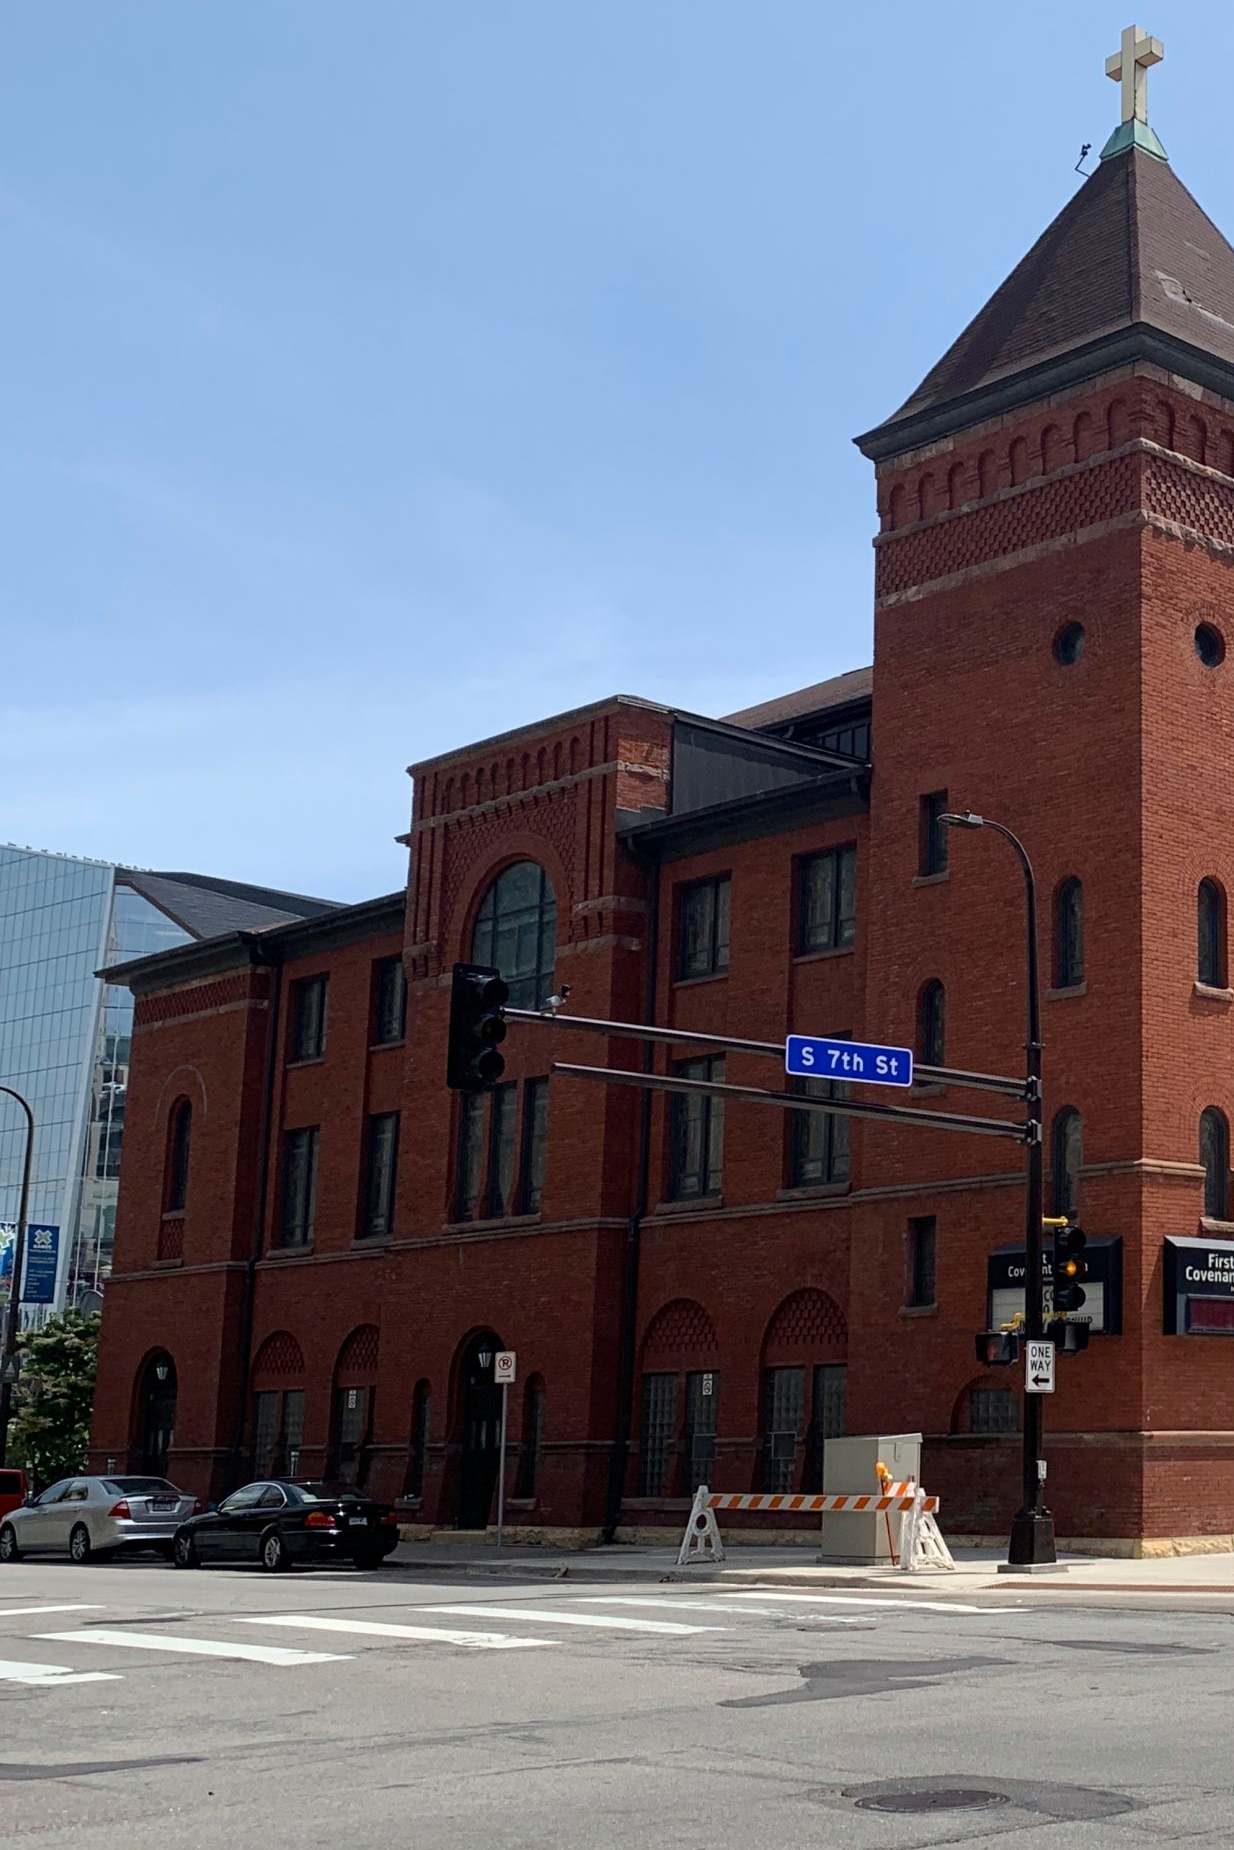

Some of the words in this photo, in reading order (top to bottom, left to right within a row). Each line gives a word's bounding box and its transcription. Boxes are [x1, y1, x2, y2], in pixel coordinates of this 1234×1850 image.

[801, 1046, 815, 1066] S
[827, 1049, 864, 1072] 7th
[875, 1055, 899, 1076] St
[1007, 1264, 1053, 1278] Covnt
[1031, 1346, 1051, 1358] ONE
[1030, 1360, 1051, 1371] WAY
